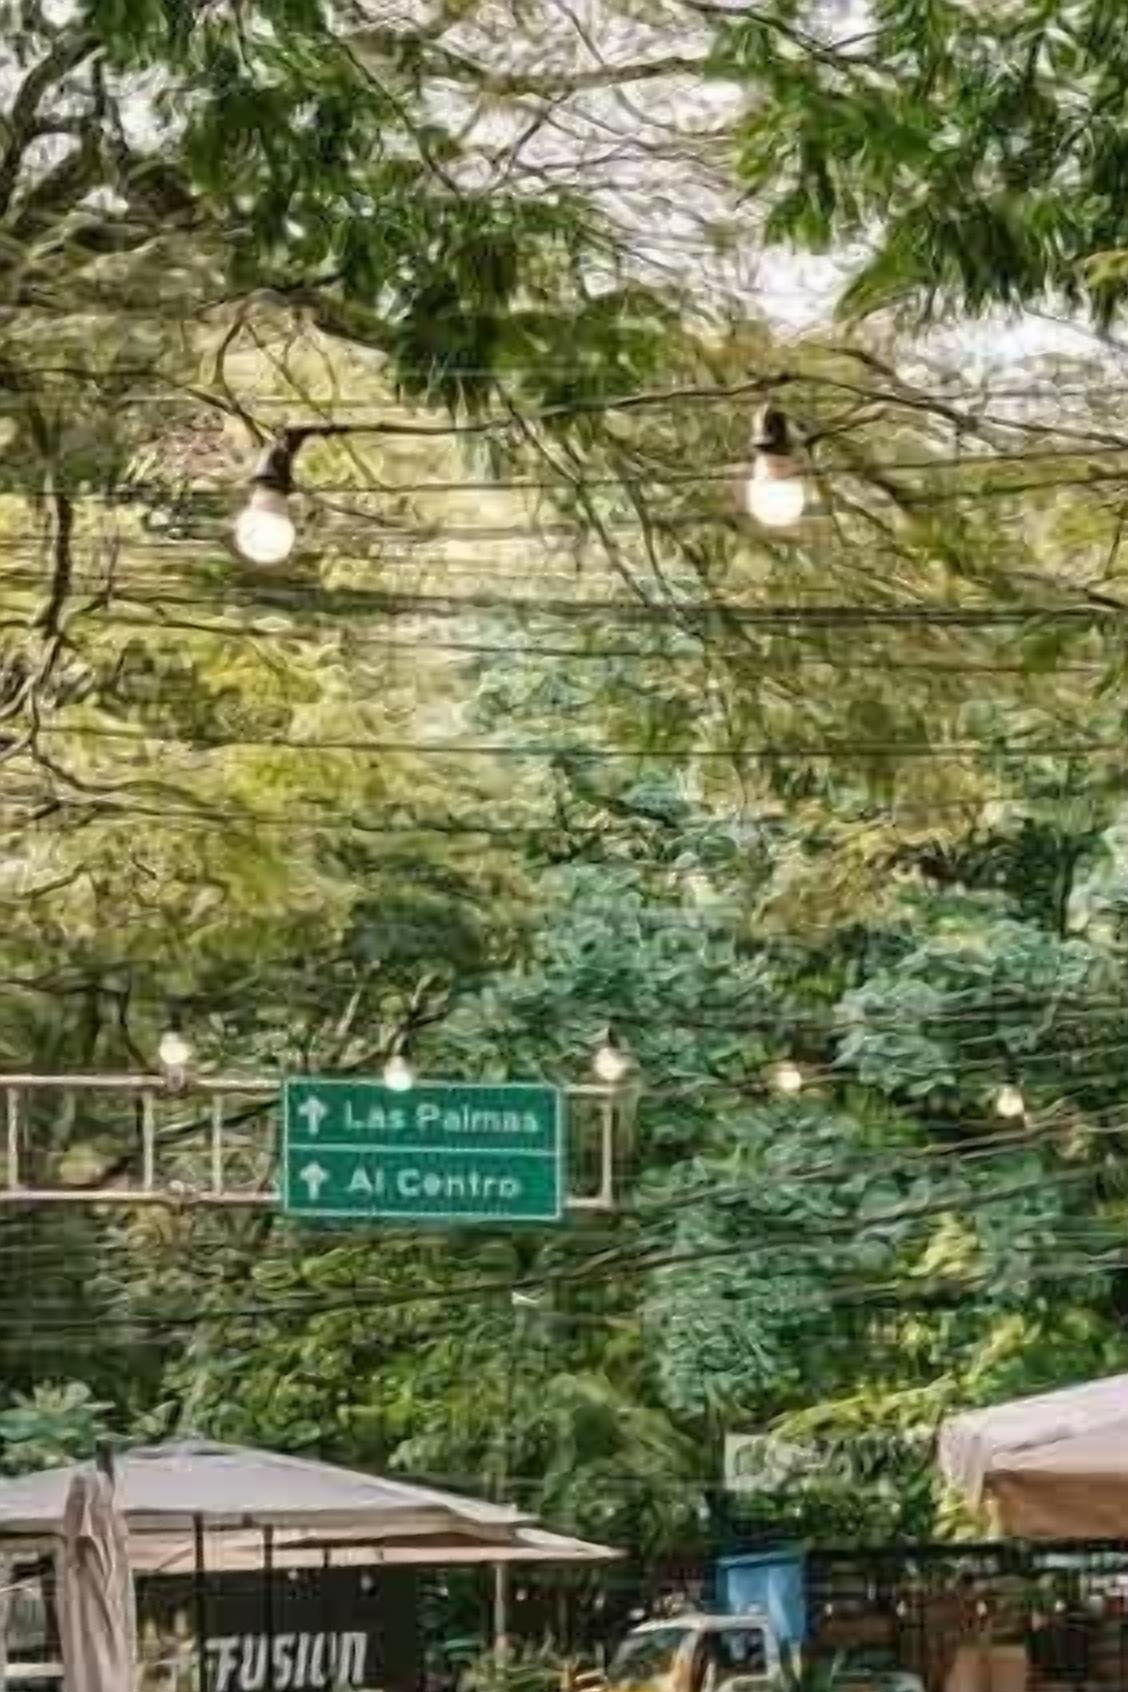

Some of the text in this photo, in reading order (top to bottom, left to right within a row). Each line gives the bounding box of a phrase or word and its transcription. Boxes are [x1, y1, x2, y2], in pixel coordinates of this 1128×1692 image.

[345, 1100, 540, 1133] Las Palmas
[348, 1166, 521, 1199] Al Centro
